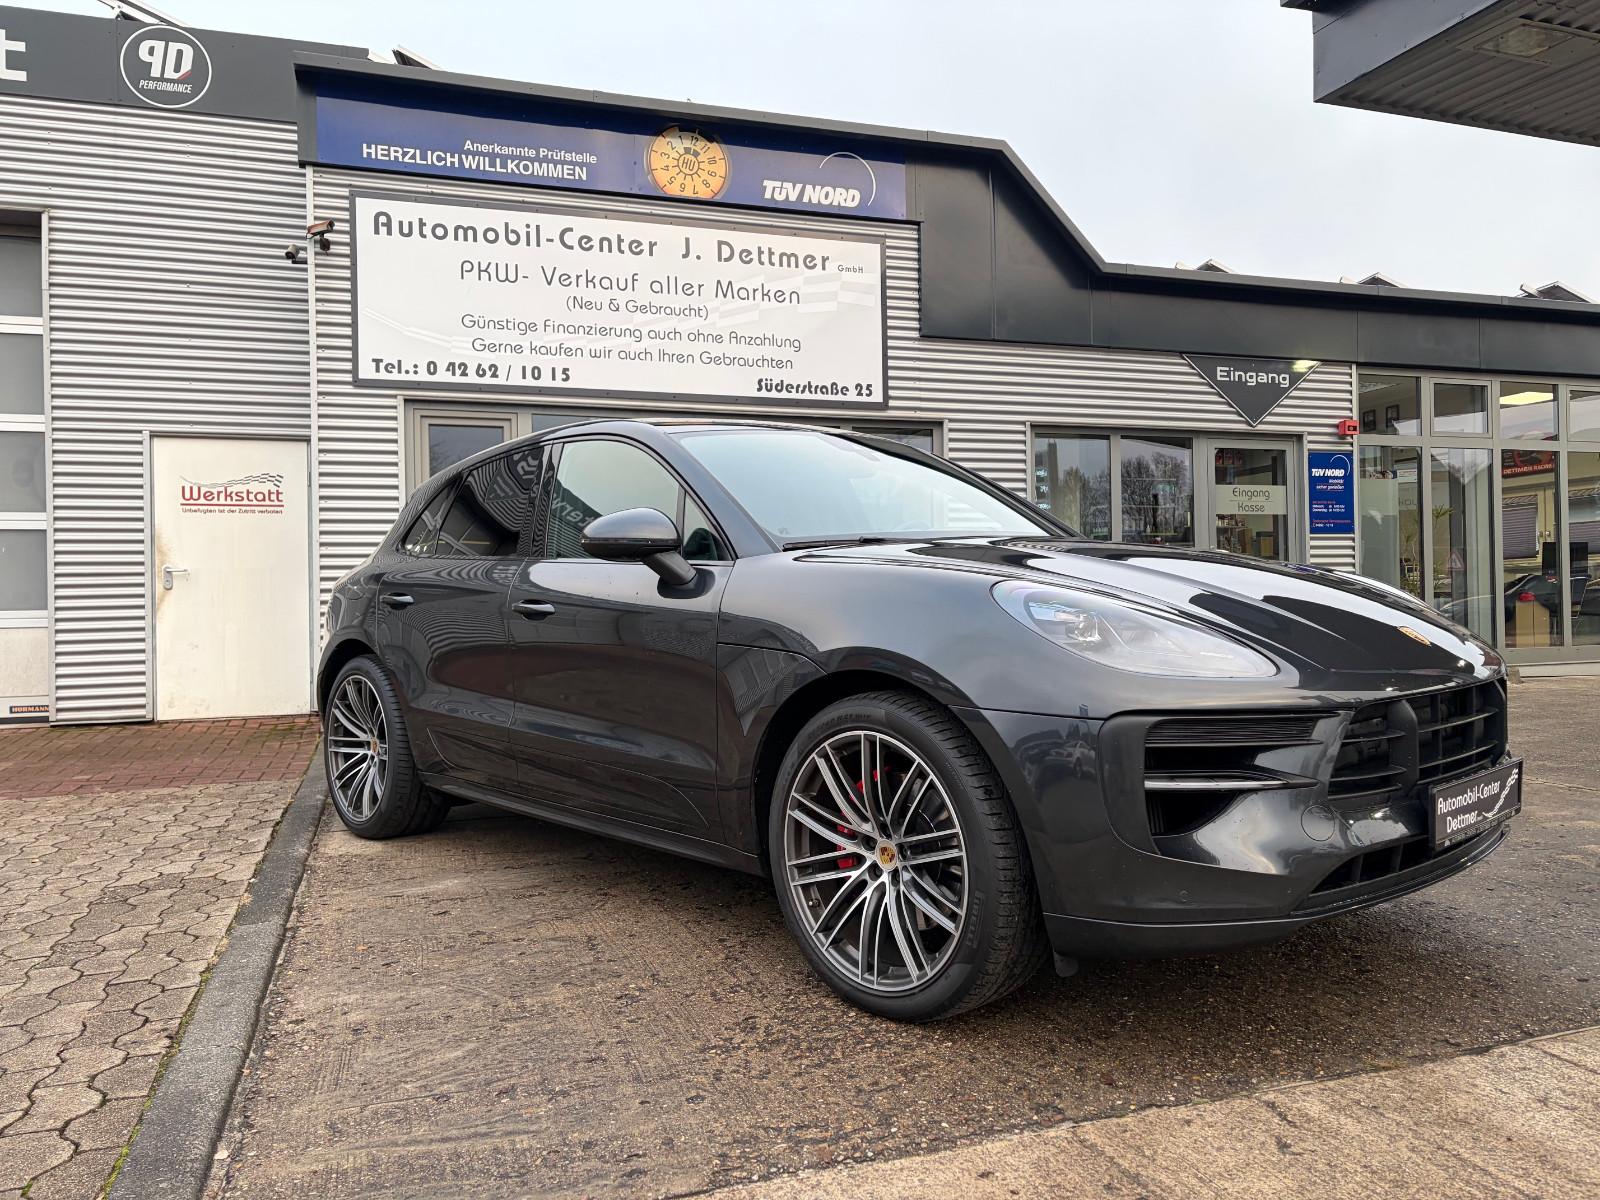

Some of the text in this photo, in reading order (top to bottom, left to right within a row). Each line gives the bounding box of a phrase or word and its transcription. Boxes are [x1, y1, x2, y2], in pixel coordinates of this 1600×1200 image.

[139, 79, 193, 93] PERFORMANCE
[463, 139, 598, 164] Anerkannte Prüfstelle
[660, 151, 670, 159] 3
[666, 140, 676, 150] 2
[362, 143, 587, 181] HERZLICH WILLKOMMEN
[681, 156, 696, 171] HU
[701, 179, 711, 188] 8
[763, 179, 861, 208] TÜV NORD
[373, 210, 864, 274] Automobil-Center J. Dettmer GmbH
[460, 259, 800, 305] PKW- Verkauf aller Marken
[566, 295, 709, 321] (Neu & Gebraucht)
[461, 313, 801, 353] Günstige Finanzierung auch ohne Anzahlung
[471, 337, 793, 370] Gerne kaufen wir auch Ihren Gebrauchten
[371, 358, 419, 375] Tel.:
[426, 360, 437, 376] 0
[475, 363, 499, 379] 62
[505, 364, 512, 382] /
[521, 365, 541, 381] 10
[551, 367, 571, 382] 15
[1216, 366, 1290, 388] Eingang
[756, 378, 873, 397] Süderstraße 25
[1311, 468, 1345, 477] TÜV NORD
[181, 485, 284, 503] Werkstatt
[1232, 487, 1271, 500] Eingang
[1237, 501, 1265, 513] Kasse
[1437, 780, 1501, 815] Automobil-Center
[1446, 810, 1478, 833] Dettmer
